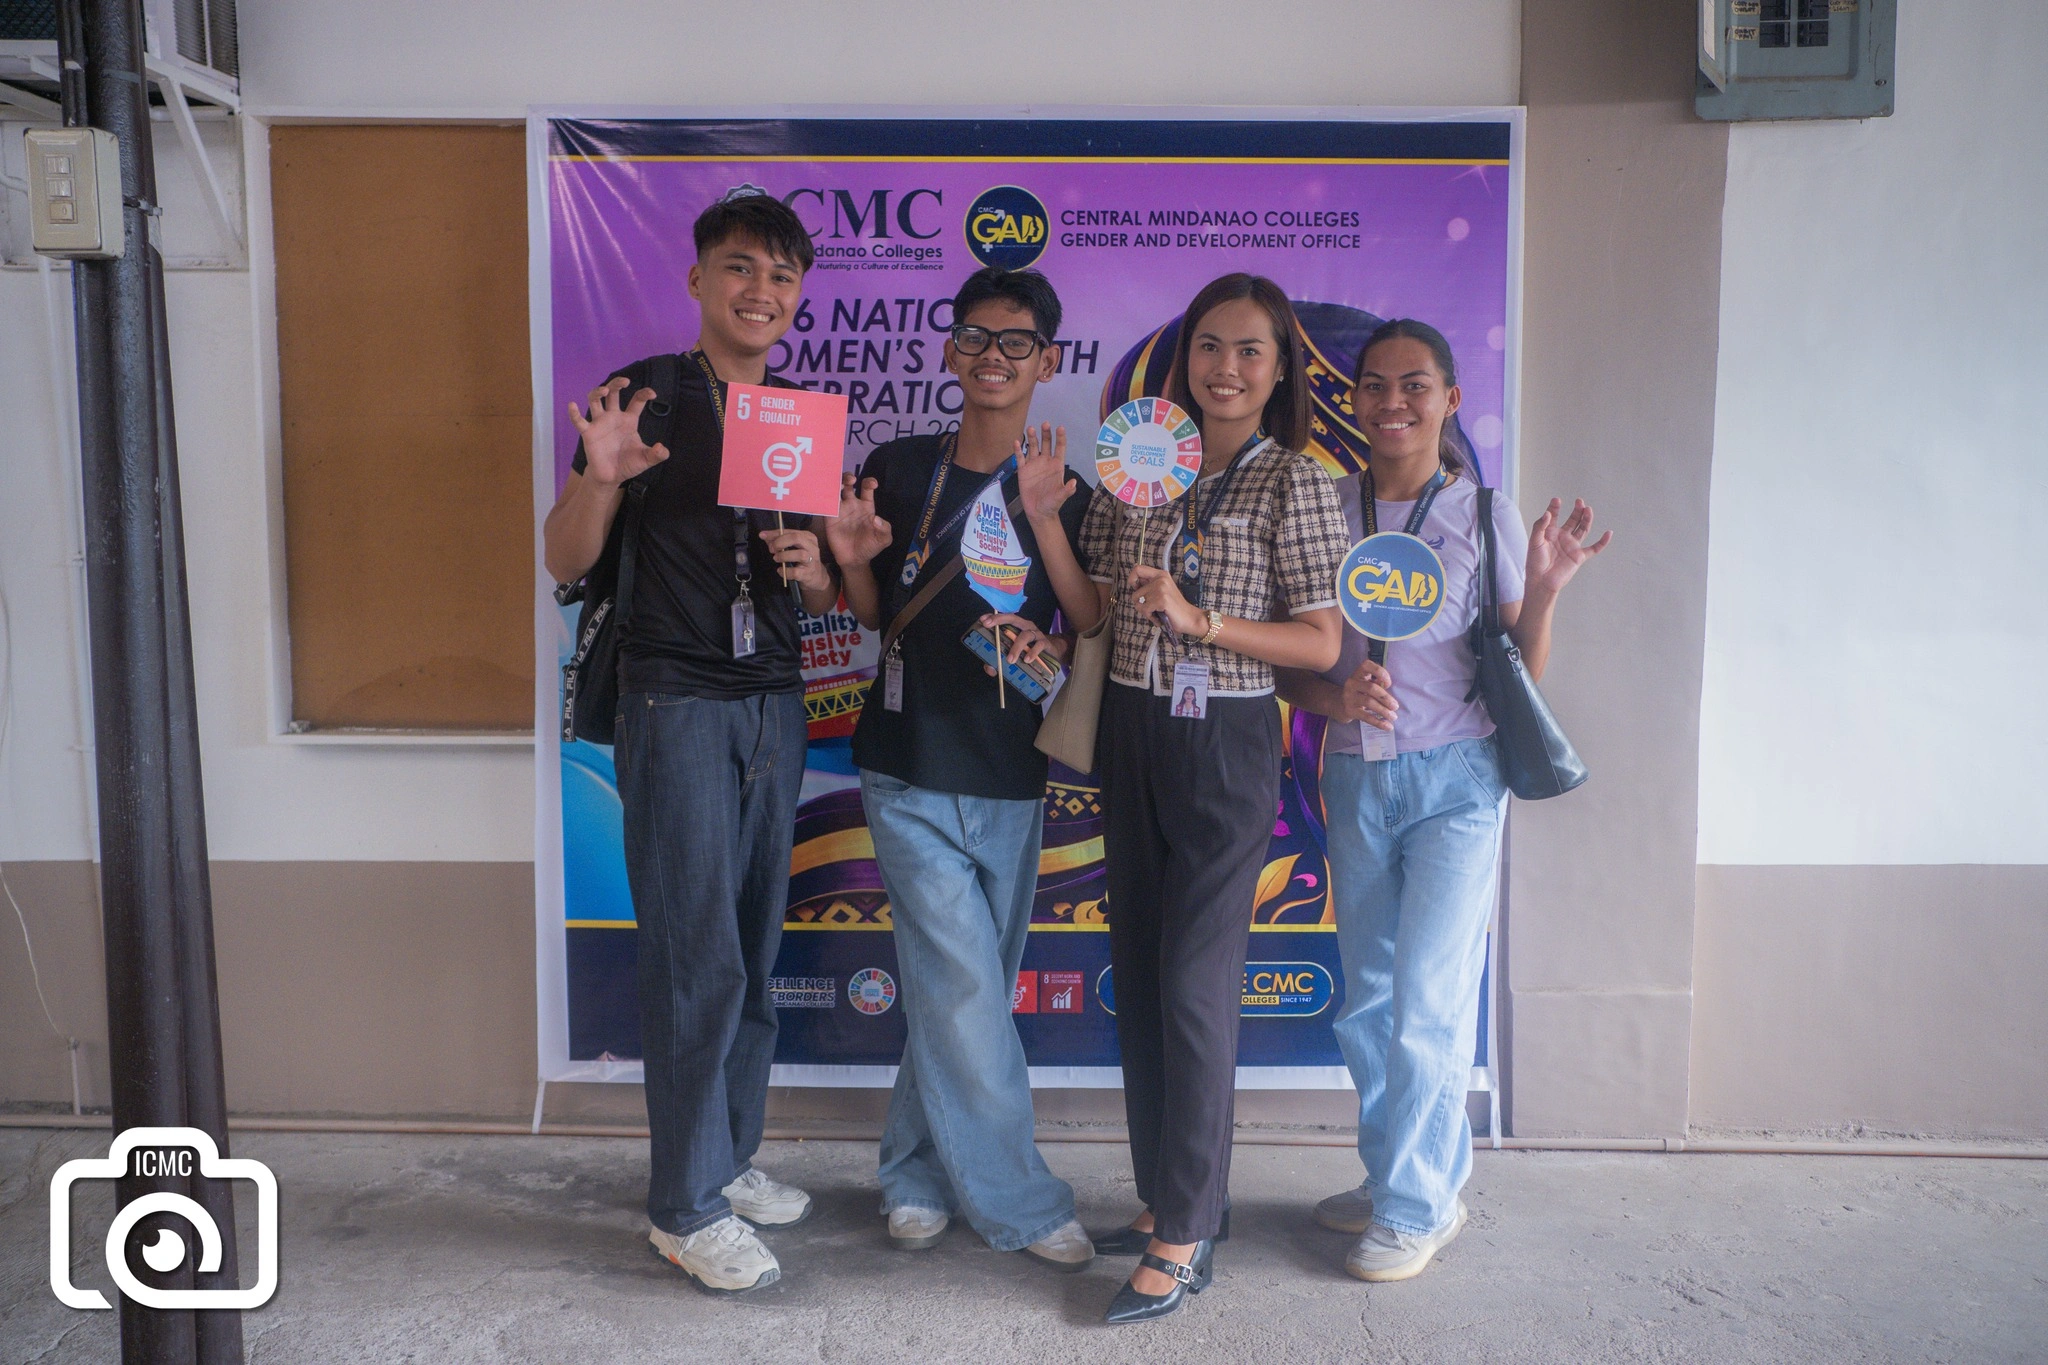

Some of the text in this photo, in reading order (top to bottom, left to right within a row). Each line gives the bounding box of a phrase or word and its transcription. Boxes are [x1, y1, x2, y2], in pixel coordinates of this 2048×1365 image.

[1060, 210, 1360, 227] CENTRAL MINDANAO COLLEGES
[972, 213, 1045, 243] GAD
[1060, 233, 1361, 248] GENDER AND DEVELOPMENT OFFICE
[814, 244, 943, 261] danao Colleges
[816, 263, 851, 271] Nurturing
[865, 262, 889, 270] Culture
[891, 262, 899, 270] of
[901, 263, 944, 271] Excellence
[830, 298, 955, 333] NATIO
[767, 339, 926, 374] OMEN'S
[737, 394, 751, 420] 5
[760, 396, 795, 411] GENDER
[759, 411, 801, 426] EQUALITY
[848, 420, 915, 445] RCH
[1131, 444, 1167, 452] SUSTAINABLE
[1130, 455, 1165, 467] GOALS
[919, 507, 935, 539] CENTRAL
[932, 464, 948, 508] MINDANAO
[976, 514, 1000, 528] Gender
[1188, 500, 1196, 530] CENTRAL
[1366, 504, 1375, 535] NDANAO
[976, 530, 1008, 548] Inclusive
[981, 524, 1008, 540] Equality
[979, 540, 1004, 556] Society
[1357, 556, 1378, 565] CMC
[1347, 565, 1438, 607] GAD
[594, 603, 609, 622] FILA
[800, 613, 859, 637] uality
[583, 627, 595, 647] FILA
[801, 632, 862, 653] usive
[577, 651, 585, 661] LA
[801, 650, 852, 670] ciety
[566, 669, 576, 690] FILA
[564, 697, 573, 719] FILA
[767, 978, 834, 989] CELLENCE
[1043, 974, 1049, 984] 8
[1253, 972, 1314, 993] CMC
[777, 991, 834, 1001] BORDERS
[1242, 996, 1277, 1004] OLLEGES
